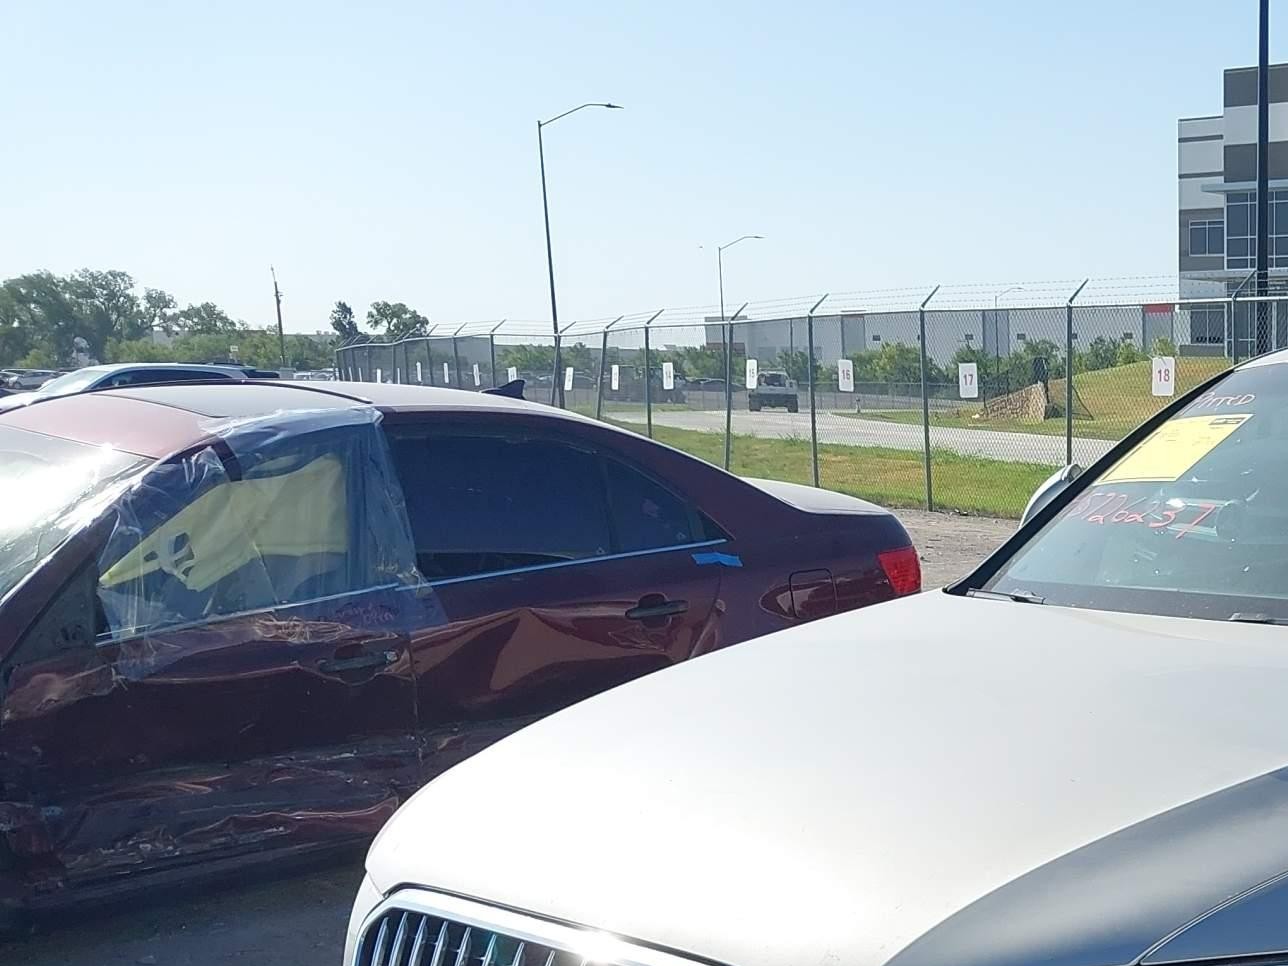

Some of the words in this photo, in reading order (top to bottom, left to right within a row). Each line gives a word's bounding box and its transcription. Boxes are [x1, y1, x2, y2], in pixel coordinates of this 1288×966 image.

[842, 369, 851, 381] 16
[963, 373, 974, 386] 17
[1157, 368, 1170, 382] 18
